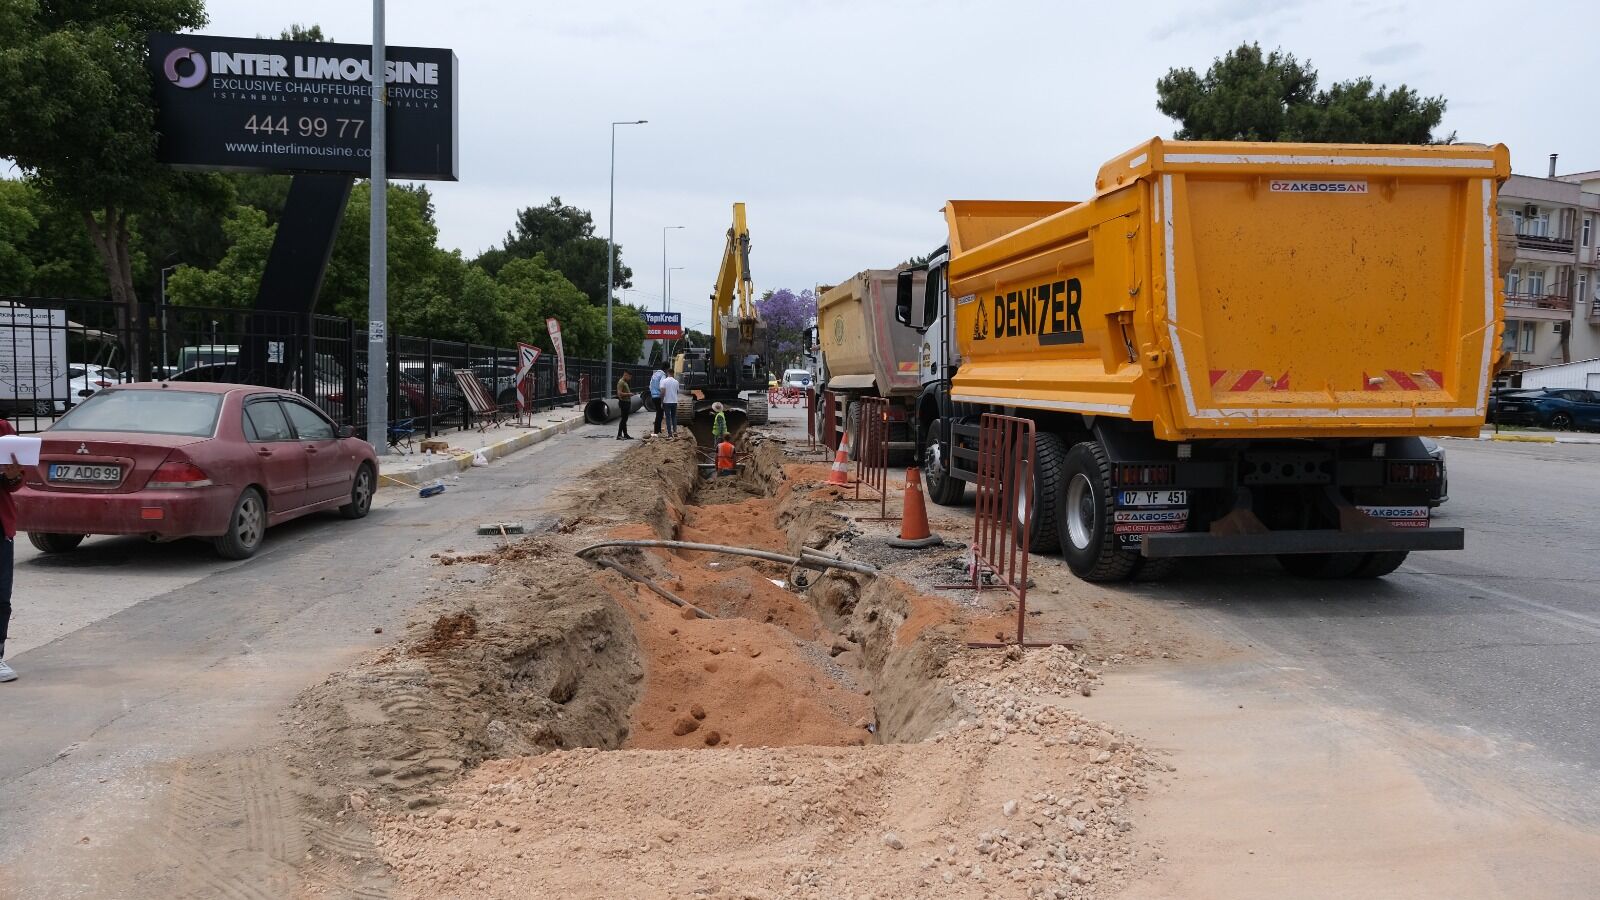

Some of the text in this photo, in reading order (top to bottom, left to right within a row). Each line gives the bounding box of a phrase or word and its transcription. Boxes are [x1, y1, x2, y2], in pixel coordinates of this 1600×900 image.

[211, 52, 438, 85] INTER LIMOUSINE
[213, 79, 282, 92] EXCLUSIVE
[388, 87, 438, 99] ERVICES
[303, 96, 360, 104] BODRUM
[244, 115, 365, 138] 444 99 77
[225, 142, 372, 157] www.interlimousine.co
[1271, 181, 1365, 192] ÖZAKBOSSAN
[56, 466, 118, 479] 07 ADG 99
[1125, 492, 1184, 504] 07 YF 451
